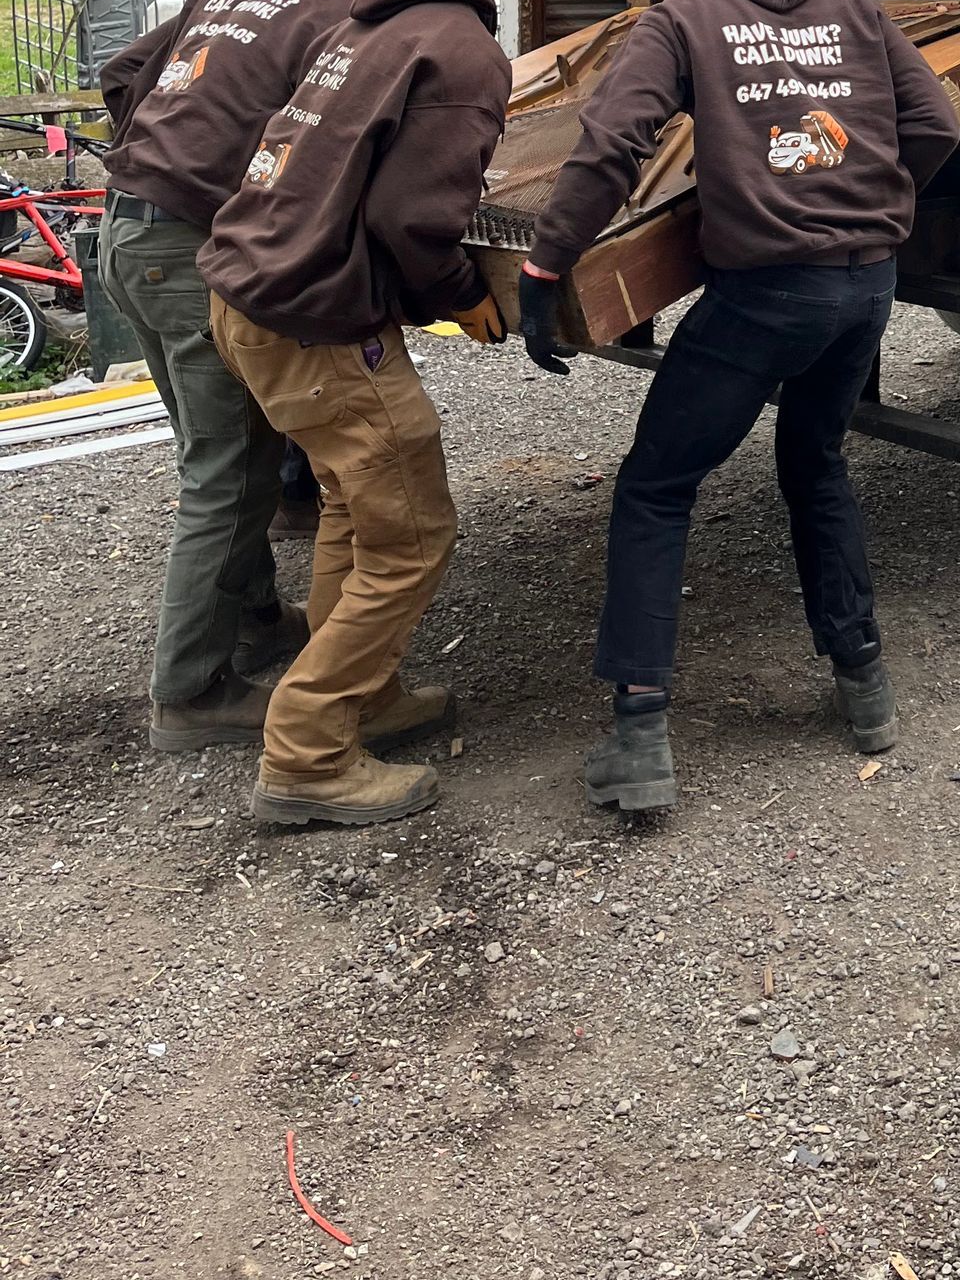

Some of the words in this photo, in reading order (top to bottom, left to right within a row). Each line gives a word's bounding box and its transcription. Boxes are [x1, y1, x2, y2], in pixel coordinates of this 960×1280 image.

[722, 22, 778, 44] HAVE
[780, 24, 842, 46] JUNK?
[734, 43, 784, 65] CALL
[783, 45, 843, 66] DUNK!
[736, 83, 773, 103] 647
